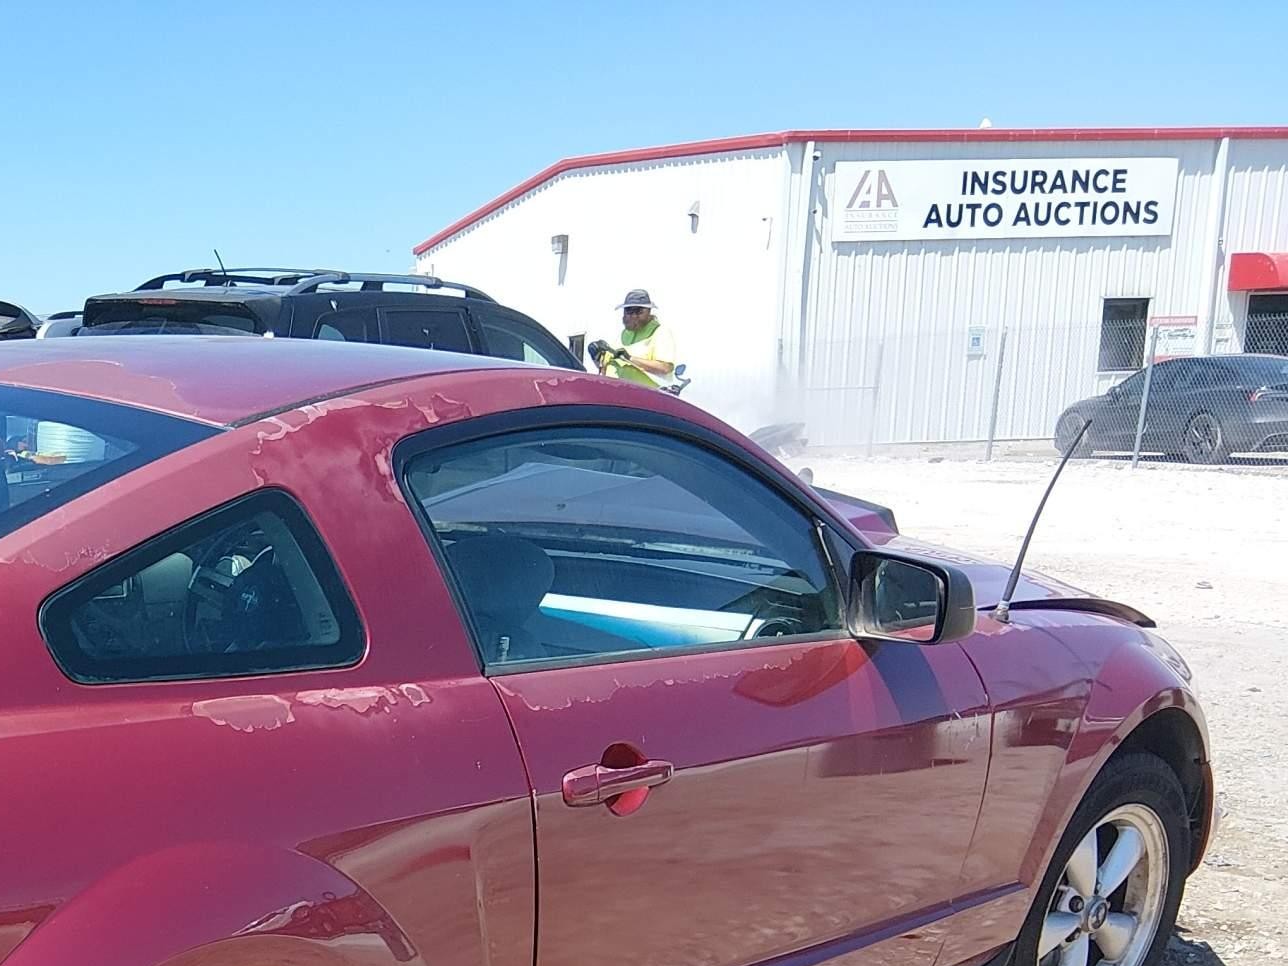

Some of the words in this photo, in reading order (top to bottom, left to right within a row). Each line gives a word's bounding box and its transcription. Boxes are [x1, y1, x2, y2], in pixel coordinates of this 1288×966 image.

[961, 169, 1128, 195] INSURANCE
[922, 202, 1004, 228] AUTO
[1012, 200, 1159, 227] AUCTIONS
